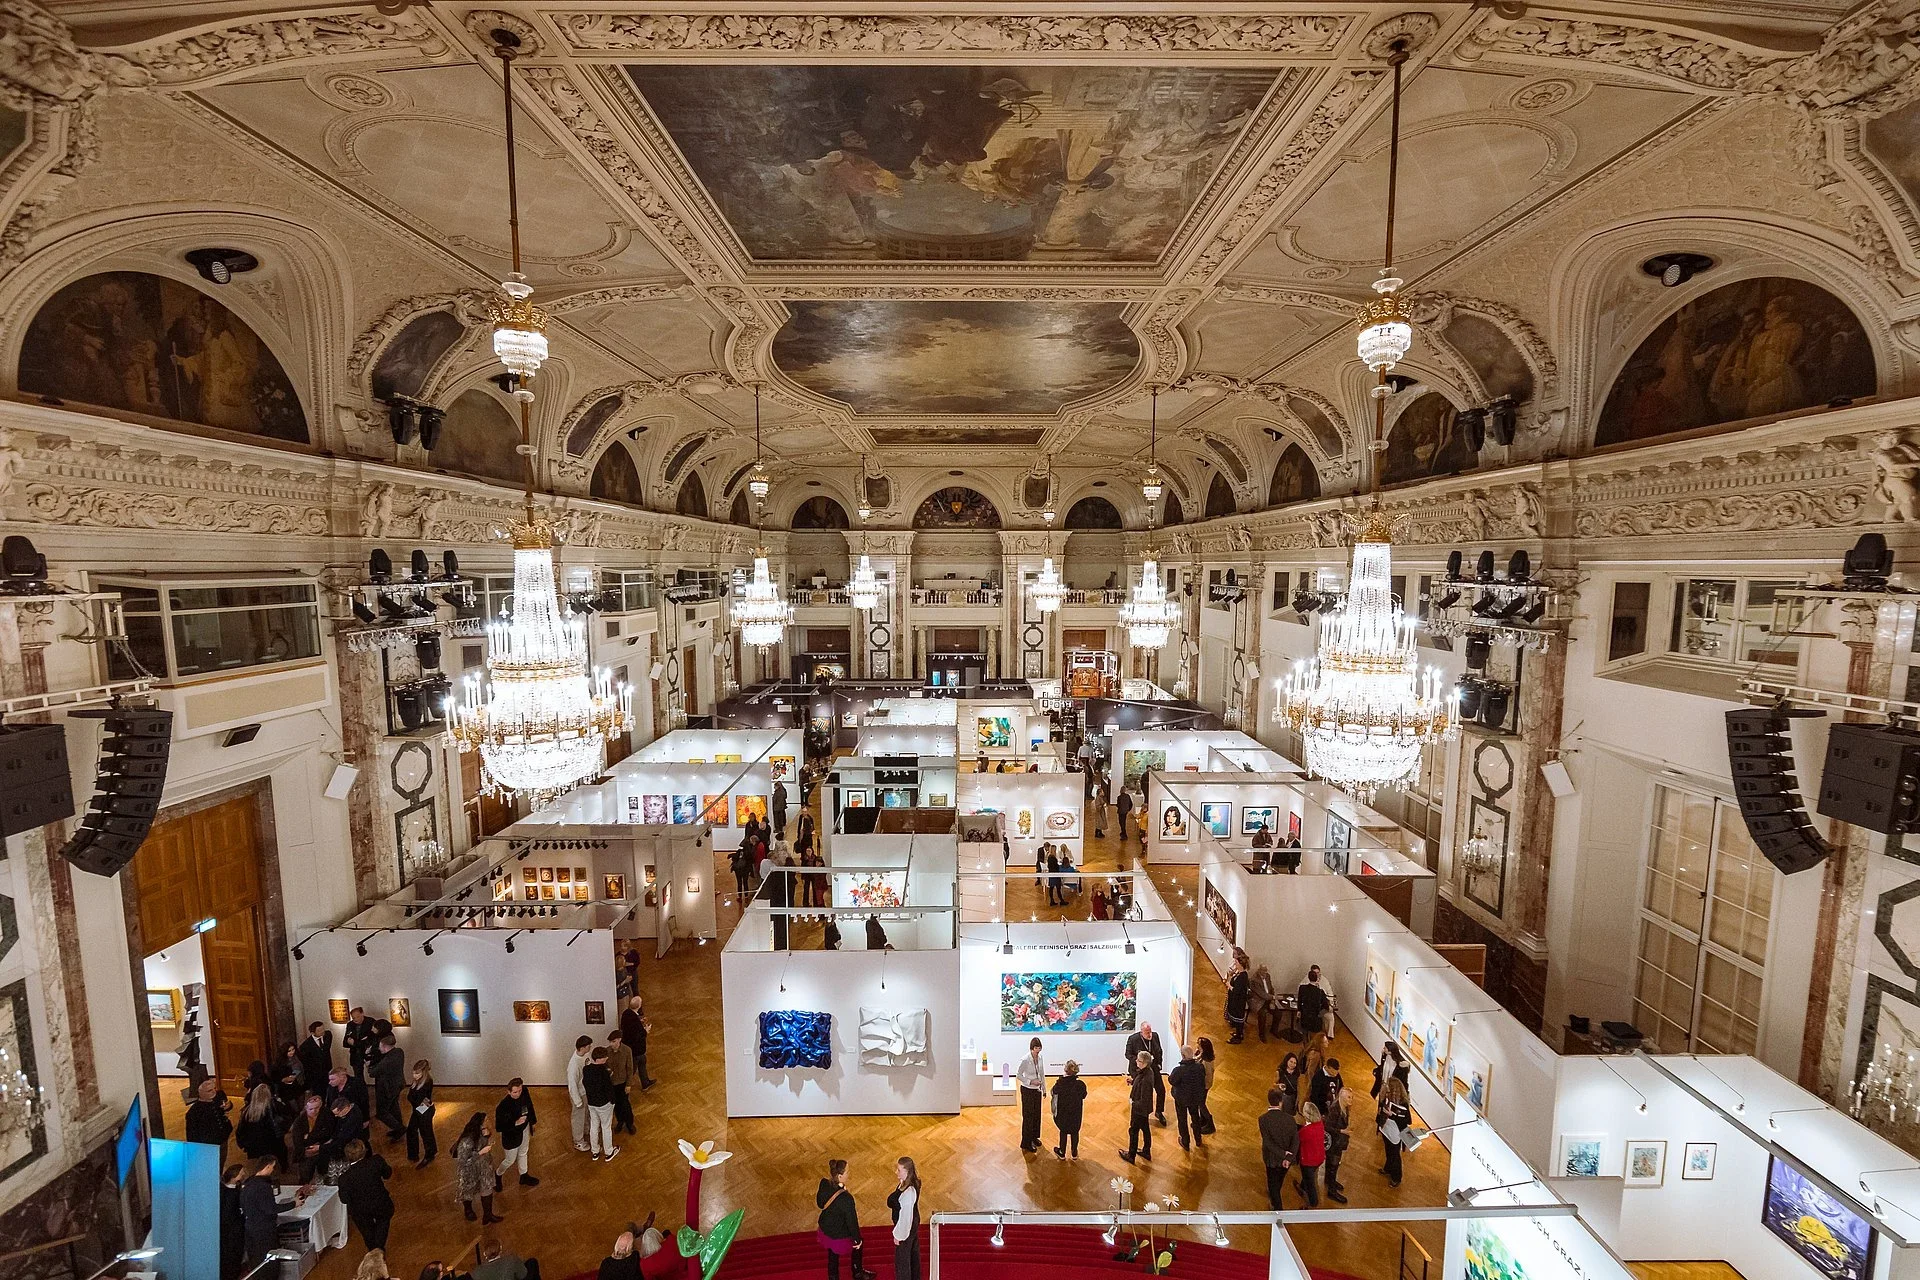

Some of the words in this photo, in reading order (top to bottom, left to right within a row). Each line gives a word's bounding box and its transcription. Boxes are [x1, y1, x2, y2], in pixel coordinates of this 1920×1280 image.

[1471, 1146, 1505, 1187] GALERIE
[1507, 1187, 1550, 1240] REISCH
[1553, 1239, 1581, 1276] GRAZ
